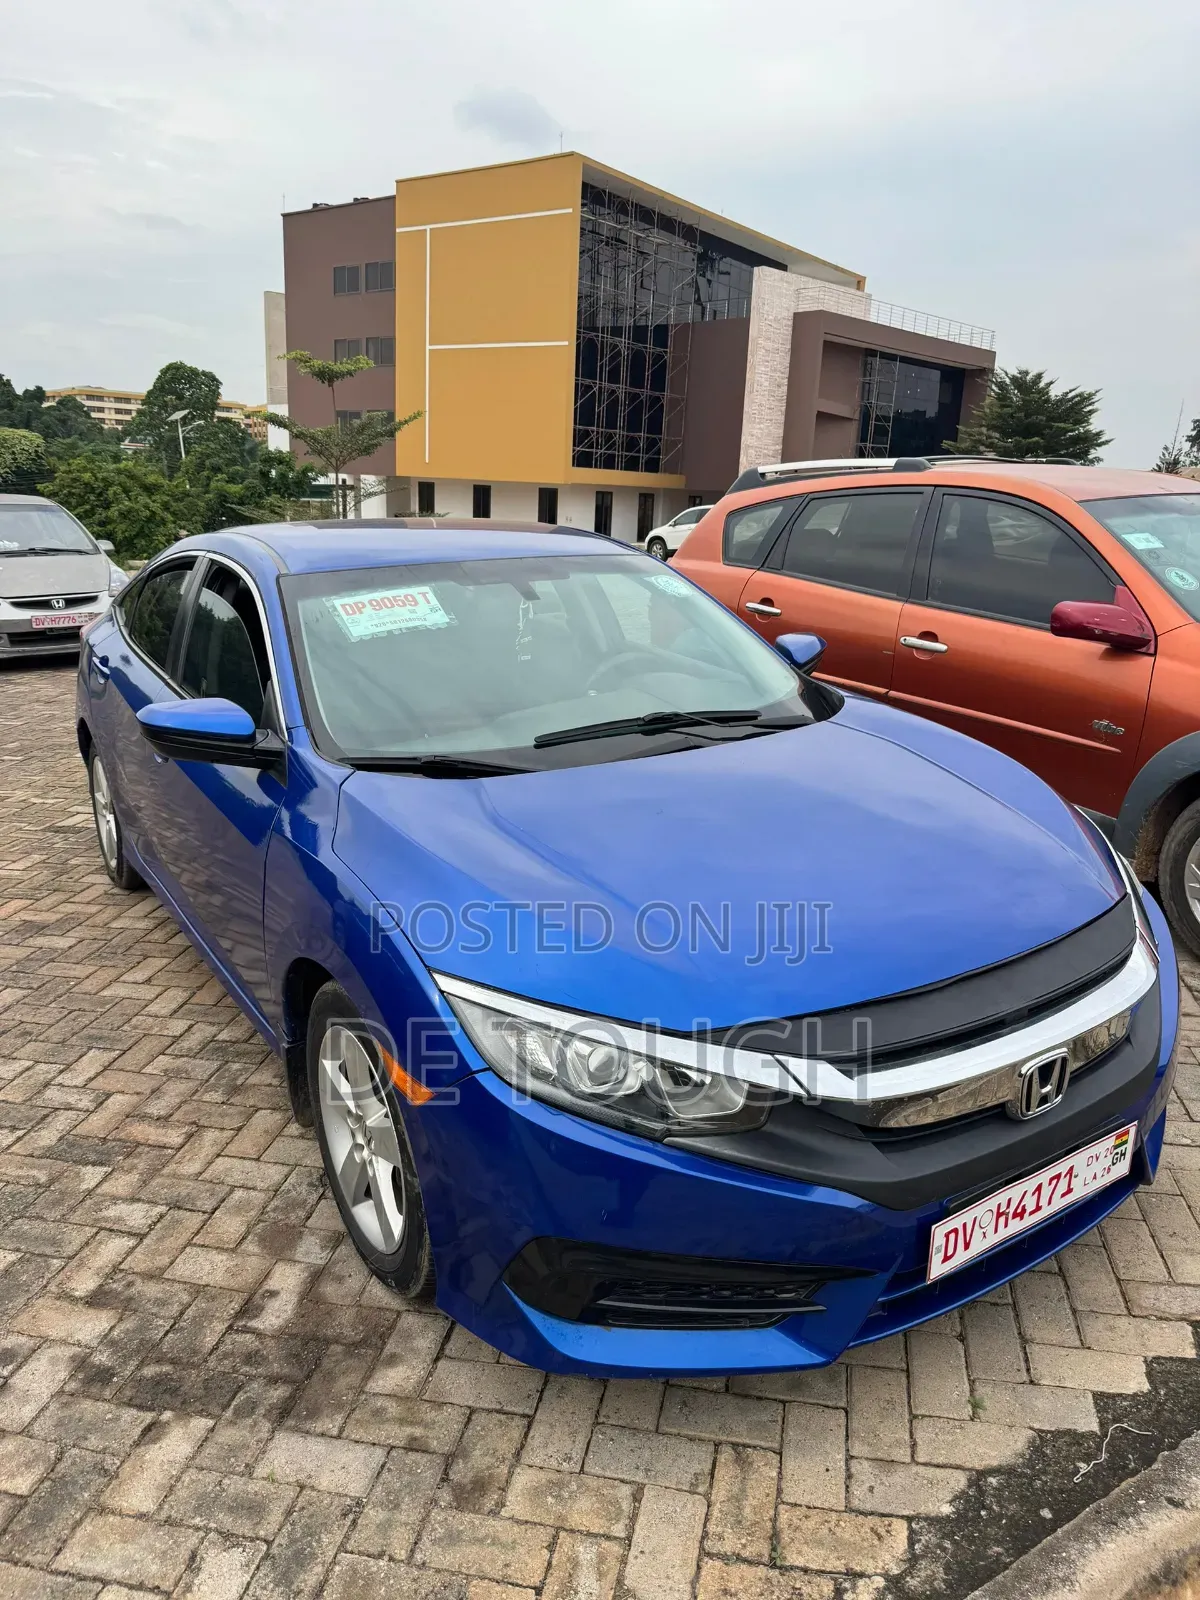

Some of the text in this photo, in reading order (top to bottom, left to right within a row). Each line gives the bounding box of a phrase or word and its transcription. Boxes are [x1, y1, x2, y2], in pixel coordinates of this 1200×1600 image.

[340, 602, 366, 616] DP
[368, 594, 419, 611] 9059
[417, 592, 431, 604] T
[34, 617, 47, 627] DV
[50, 615, 77, 626] H7776
[1086, 1151, 1102, 1167] DV
[1111, 1146, 1128, 1166] GH
[941, 1164, 1075, 1265] DV H4171
